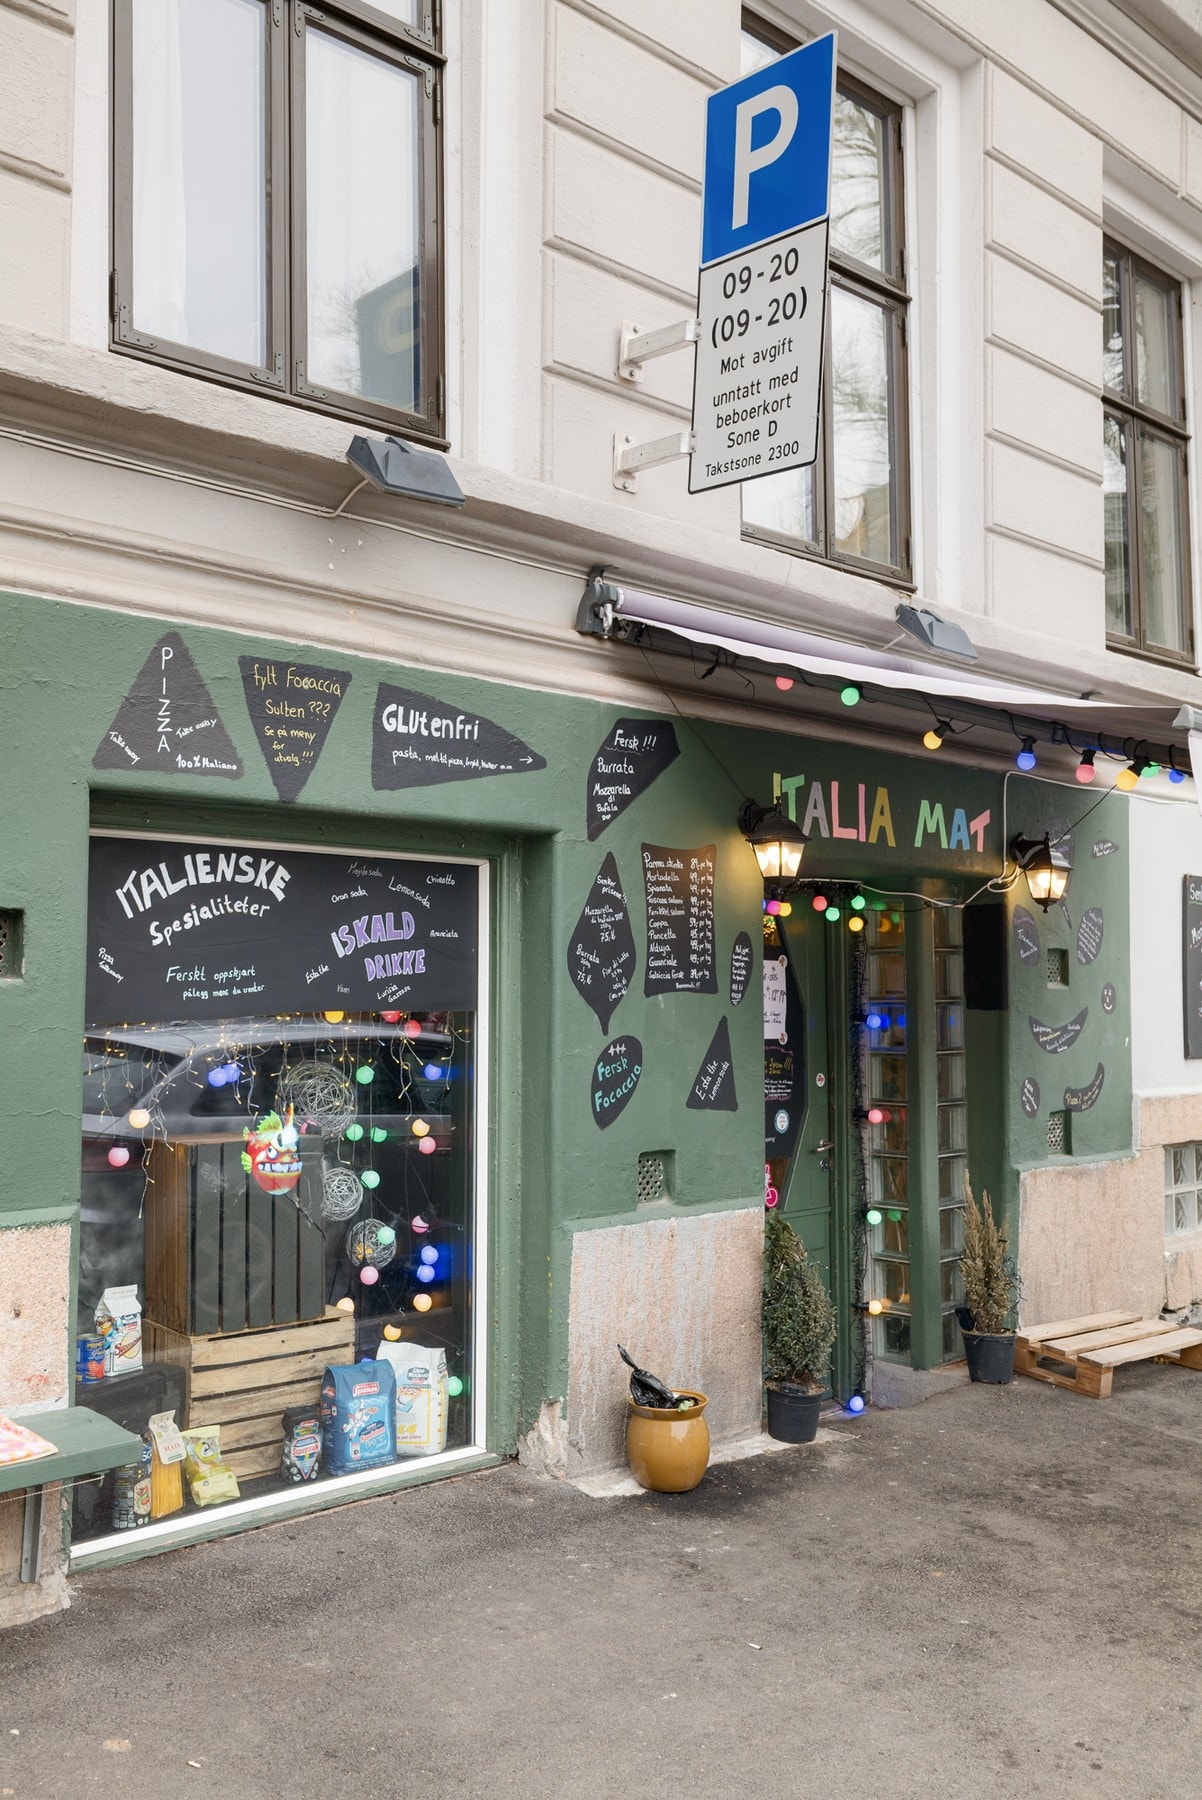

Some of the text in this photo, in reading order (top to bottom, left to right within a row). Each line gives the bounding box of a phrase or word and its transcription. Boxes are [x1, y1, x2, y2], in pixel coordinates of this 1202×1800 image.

[732, 84, 799, 230] P
[723, 247, 799, 300] 09-20
[711, 285, 808, 349] (09-20)
[720, 337, 793, 375] Mot avgift
[713, 366, 799, 407] unntatt med
[716, 394, 792, 429] beboerkort
[727, 419, 778, 449] Sone D
[705, 440, 799, 478] Takstsone 2300
[286, 666, 342, 697] Focaccia
[157, 647, 173, 753] PIZZA
[265, 700, 305, 719] Sulten
[264, 725, 316, 745] Se på meny
[614, 729, 639, 751] Fersk
[176, 754, 237, 771] 100% Italiano
[274, 750, 300, 766] utvalg
[392, 746, 421, 765] pasta,
[597, 757, 635, 774] Burrata
[592, 782, 632, 796] Mozzarella
[773, 772, 991, 853] ITALIA MAT
[115, 852, 292, 920] ITALIENSKE
[646, 870, 680, 882] Mortadella
[350, 885, 369, 898] soda
[647, 882, 672, 895] Spianata
[149, 894, 271, 946] Spesialiteter
[648, 918, 670, 929] Coppa
[330, 911, 415, 958] ISKALD
[648, 928, 677, 940] Pancetta
[576, 944, 600, 964] Burrata
[648, 954, 678, 967] Guanciale
[166, 964, 206, 982] Ferskt
[364, 949, 426, 982] DRIKKE
[182, 985, 209, 1001] pålegg
[232, 985, 242, 995] du
[597, 1056, 628, 1082] Fersk
